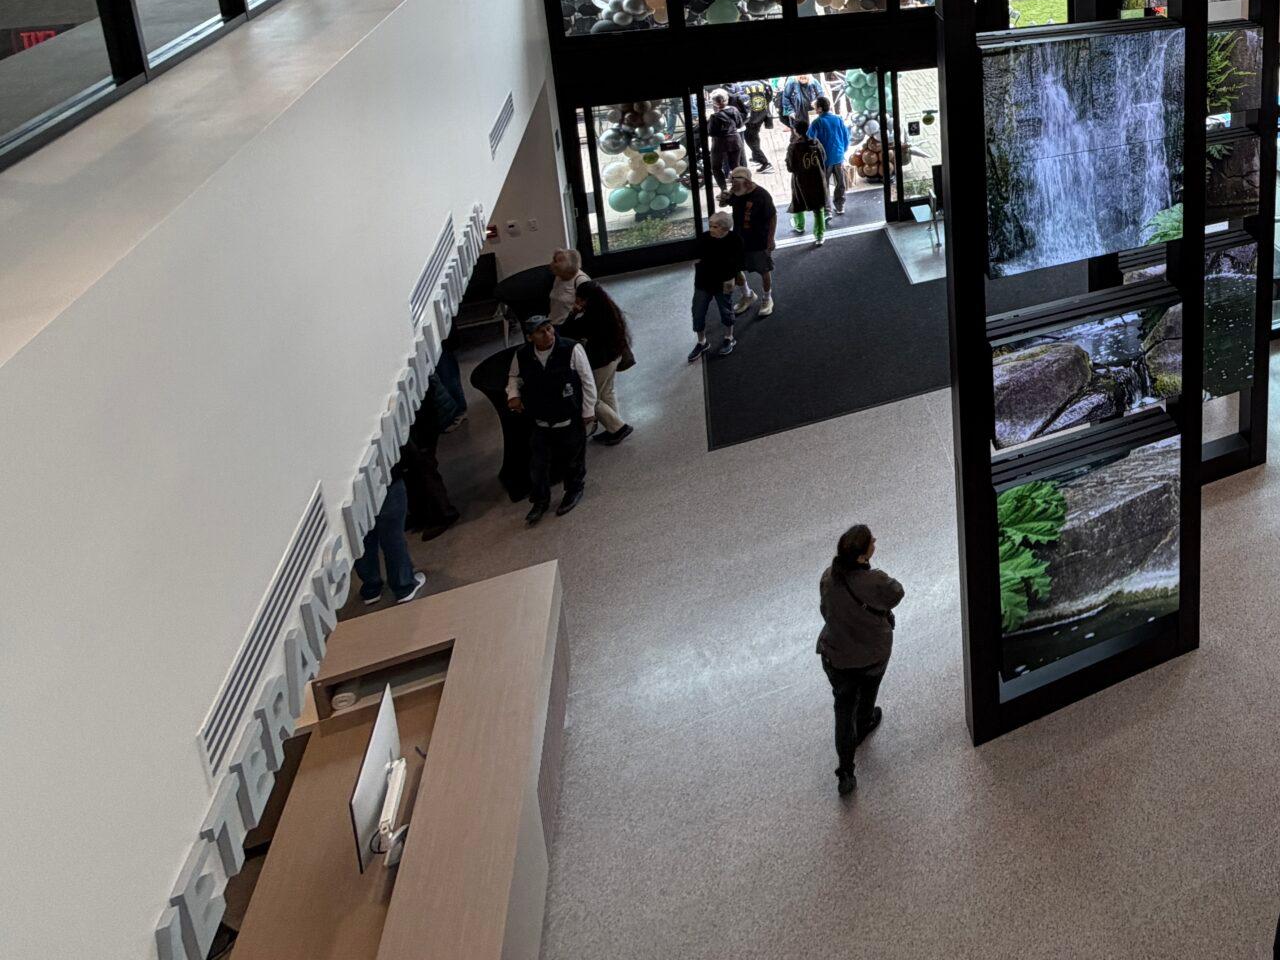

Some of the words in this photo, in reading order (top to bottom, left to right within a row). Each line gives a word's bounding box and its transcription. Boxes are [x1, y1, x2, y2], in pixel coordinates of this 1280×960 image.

[154, 533, 351, 960] ETERANS
[341, 319, 443, 560] MEMORIAL
[433, 203, 486, 339] BUILDING
